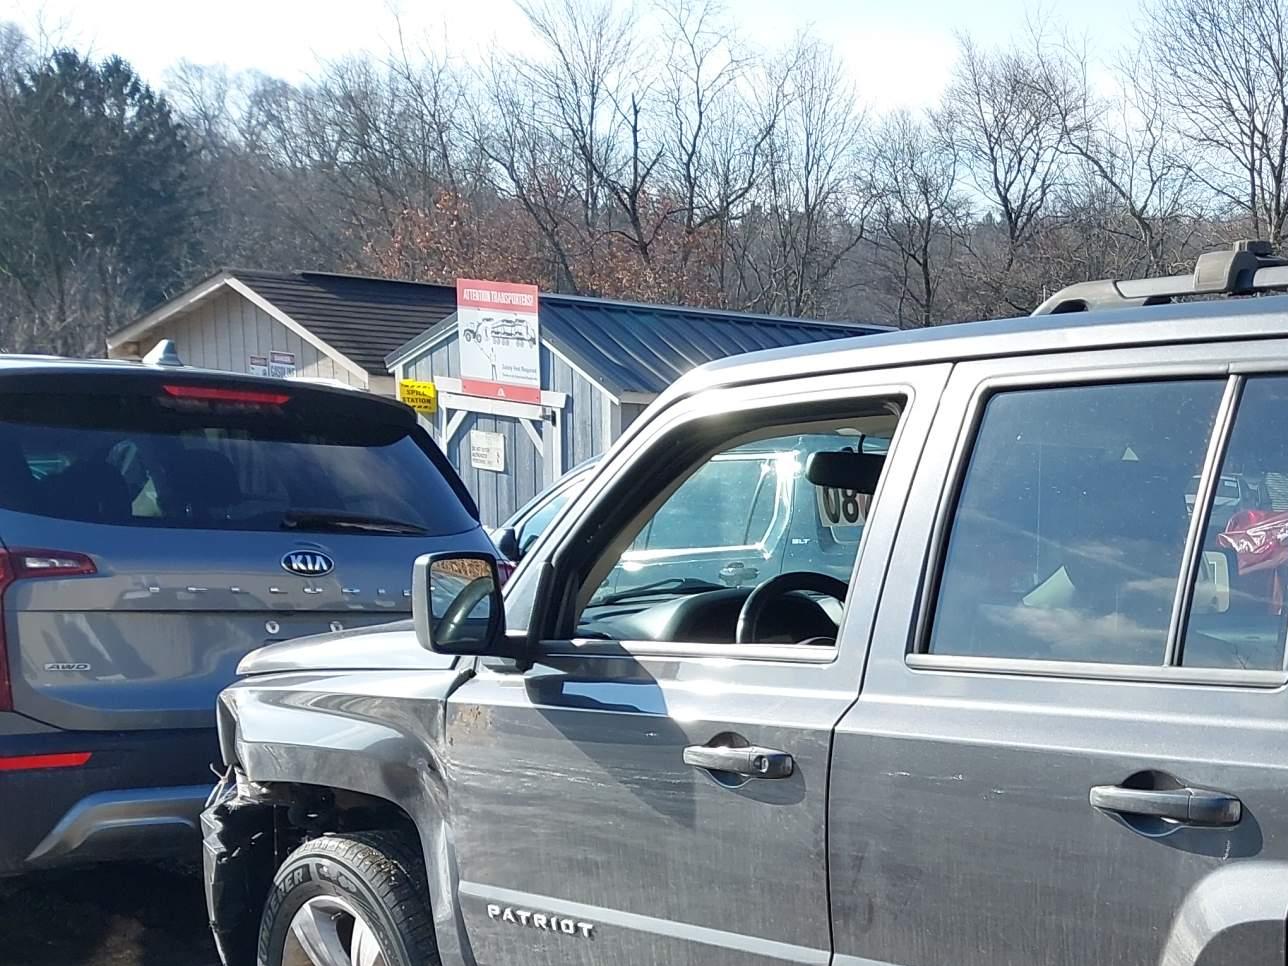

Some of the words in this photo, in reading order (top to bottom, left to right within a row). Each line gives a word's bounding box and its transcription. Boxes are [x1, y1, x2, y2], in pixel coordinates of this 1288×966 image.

[406, 389, 428, 397] SPILL
[289, 553, 328, 571] KIA
[47, 663, 91, 671] AWD
[486, 904, 595, 938] PATRIOT
